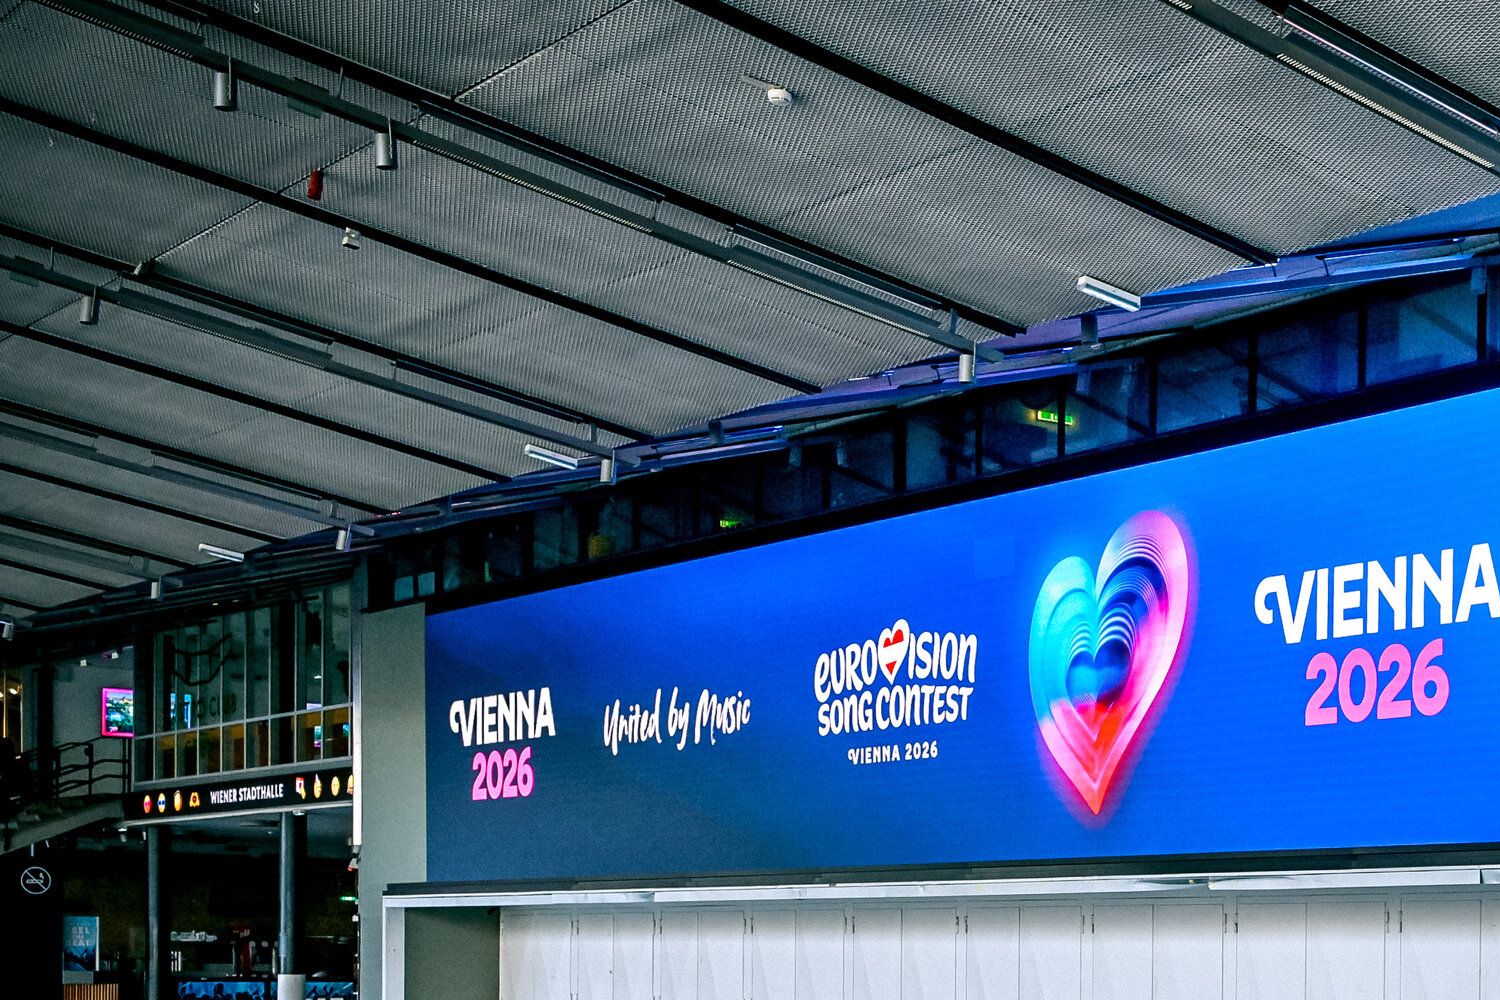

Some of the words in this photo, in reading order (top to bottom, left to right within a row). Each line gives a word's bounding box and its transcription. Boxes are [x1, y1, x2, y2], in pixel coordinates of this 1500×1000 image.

[1304, 637, 1451, 727] 2026
[449, 686, 556, 747] VIENNA
[602, 689, 663, 756] United
[668, 686, 691, 751] by
[694, 689, 752, 746] Music
[817, 695, 874, 737] SONG
[875, 684, 974, 730] CONTEST
[472, 746, 535, 801] 2026
[848, 744, 901, 766] VIENNA
[904, 740, 938, 762] 2026
[210, 788, 238, 804] WIENER
[238, 783, 284, 802] STADTHALLE
